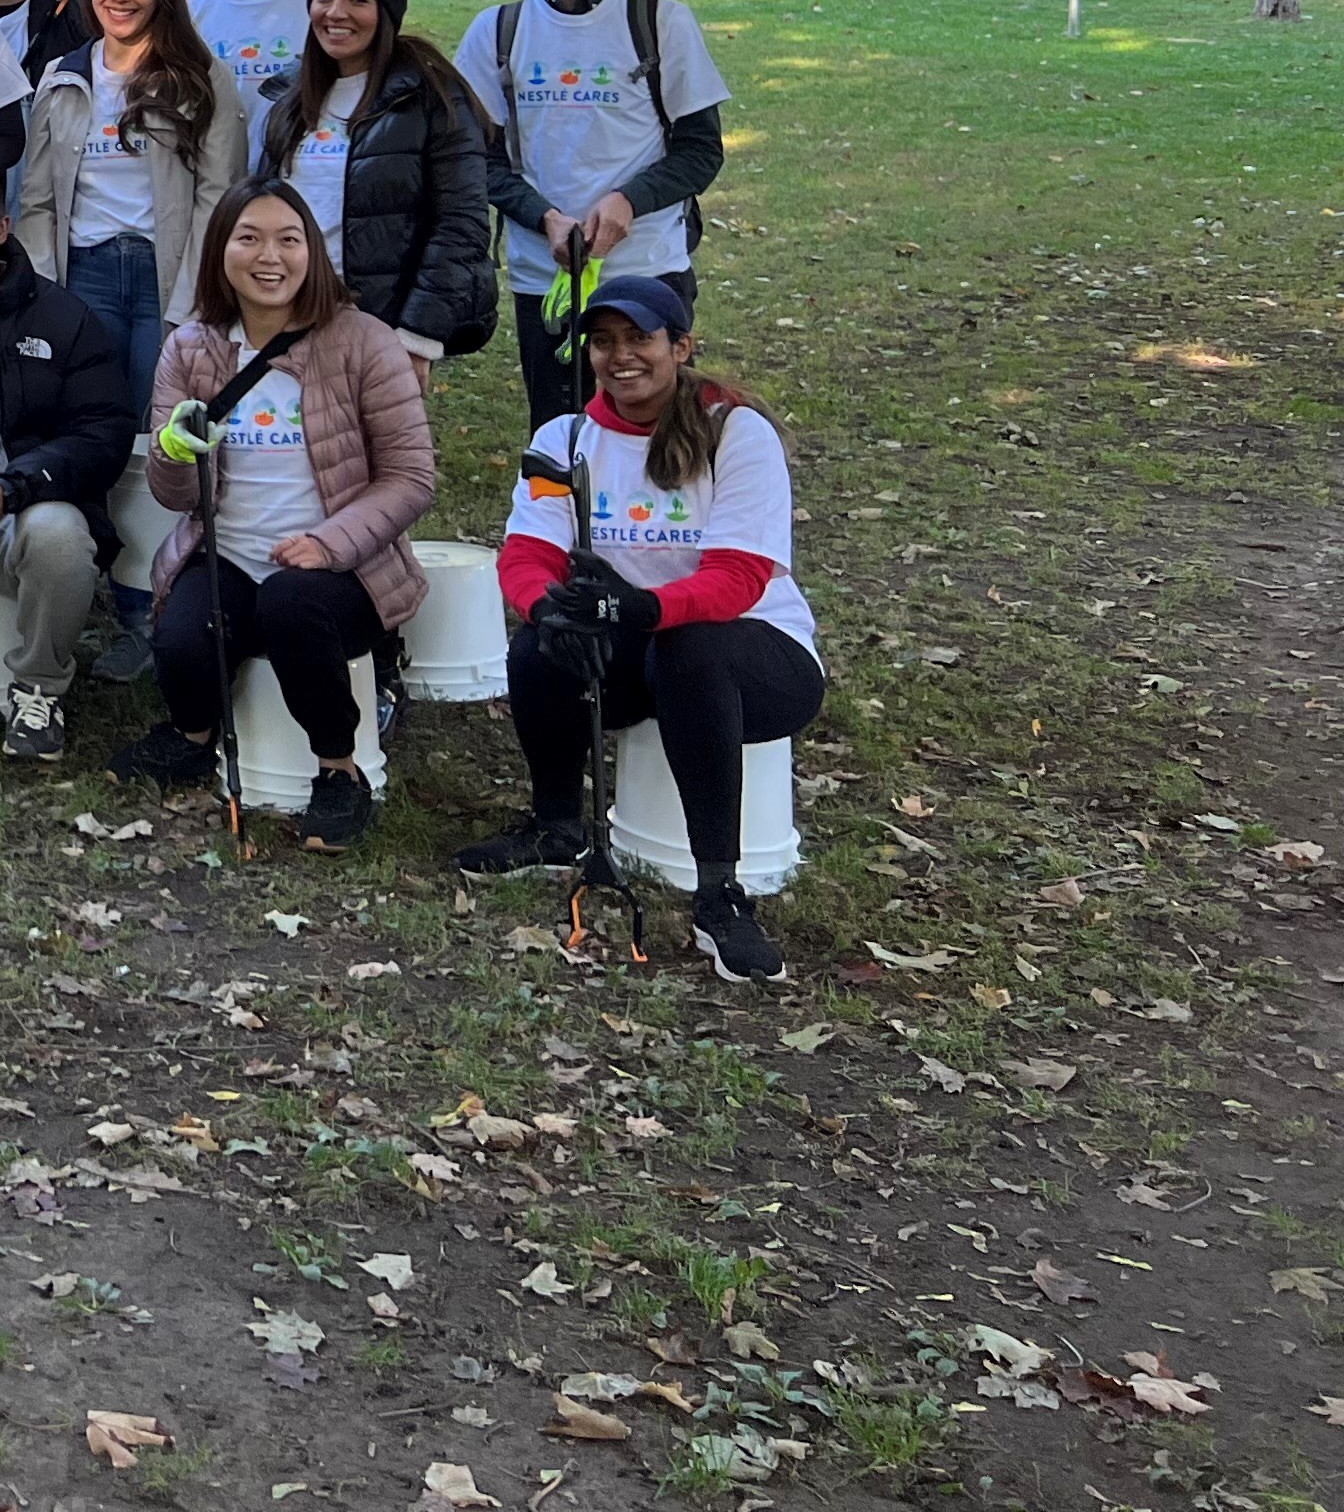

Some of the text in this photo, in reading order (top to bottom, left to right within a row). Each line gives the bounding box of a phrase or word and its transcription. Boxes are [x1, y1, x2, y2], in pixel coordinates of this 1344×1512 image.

[254, 63, 281, 75] CAR
[517, 88, 620, 104] NESTLÉ CARES
[82, 139, 109, 155] TLÉ
[321, 143, 346, 153] CAR
[223, 428, 303, 446] ESTLÉ CAR
[592, 524, 704, 544] ESTLÉ CARES
